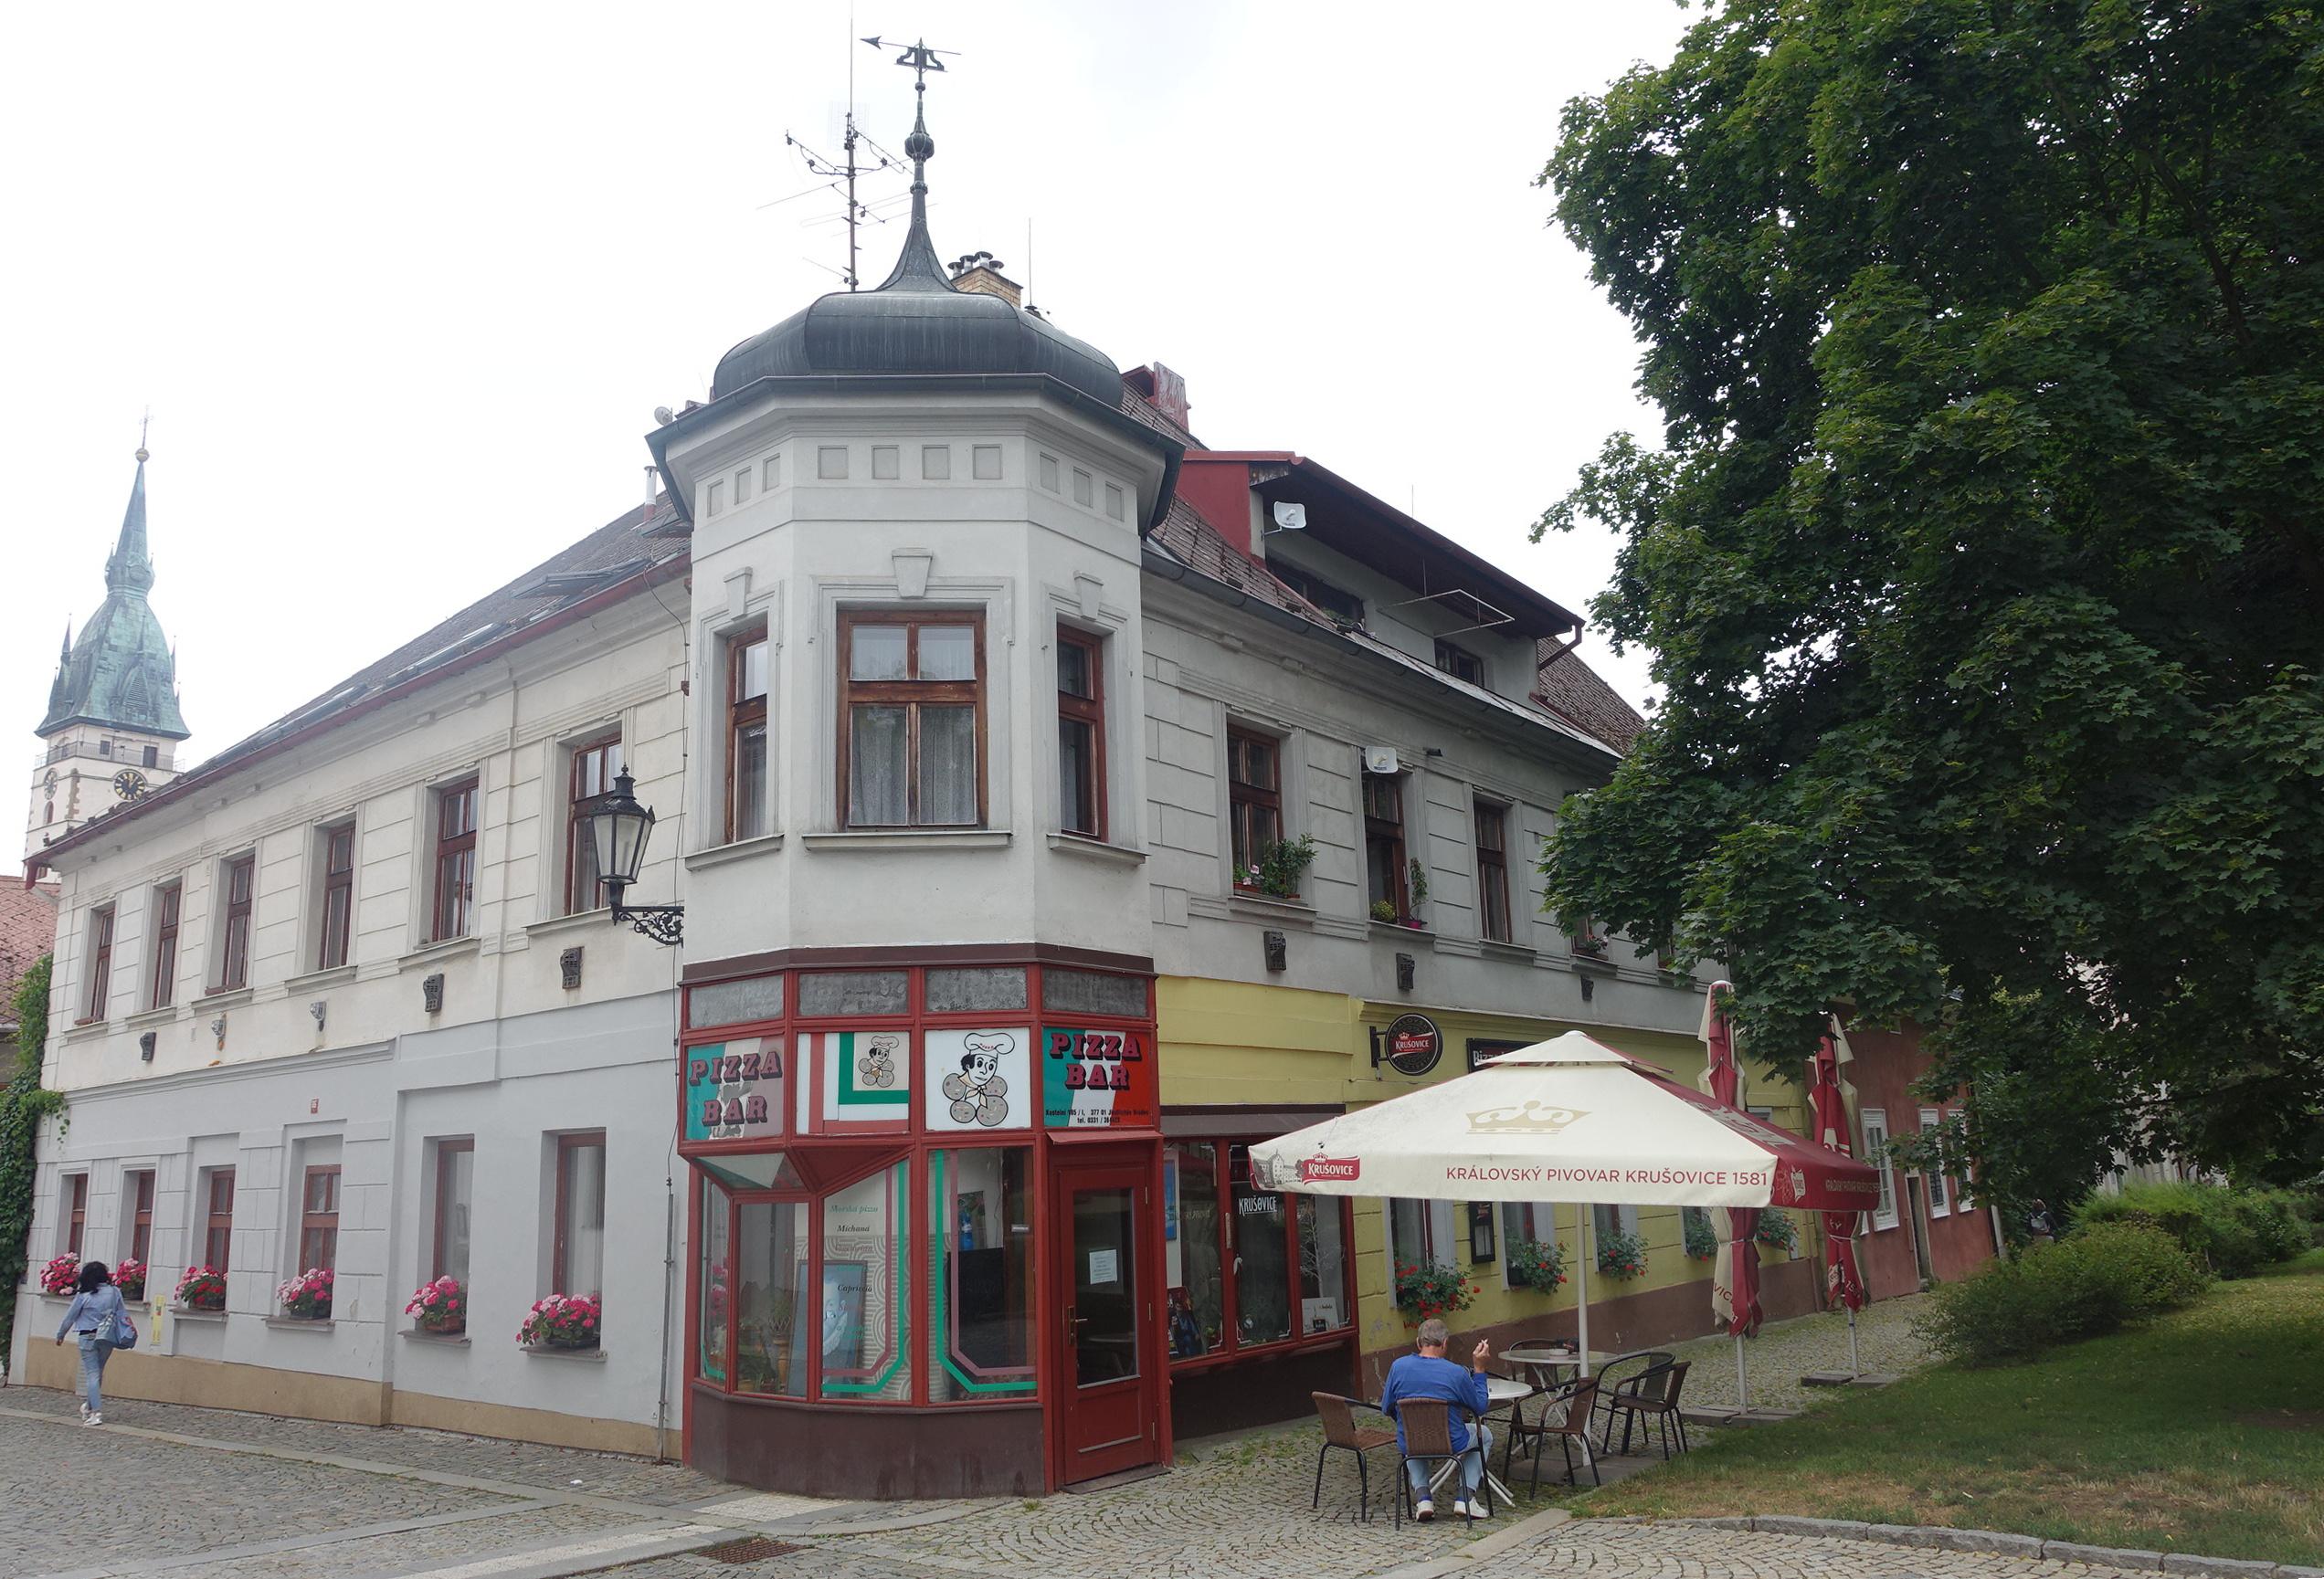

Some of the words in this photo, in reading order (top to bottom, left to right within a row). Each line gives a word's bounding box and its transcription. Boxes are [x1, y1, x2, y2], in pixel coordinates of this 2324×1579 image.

[1050, 1033, 1142, 1061] PIZZA
[1395, 1039, 1430, 1051] KRUŠOVICE
[689, 1051, 783, 1087] PIZZA
[1065, 1064, 1130, 1090] BAR
[702, 1096, 768, 1127] BAR
[1087, 1116, 1099, 1124] 0331
[1308, 1161, 1354, 1177] KRUŠOVICE
[1446, 1164, 1542, 1181] KRÁLOVSKÝ
[1547, 1168, 1620, 1182] PIVOVAR
[1626, 1168, 1727, 1184] KRUŠOVICE
[1733, 1172, 1767, 1185] 1581
[1239, 1195, 1278, 1216] KRUŠOVICE
